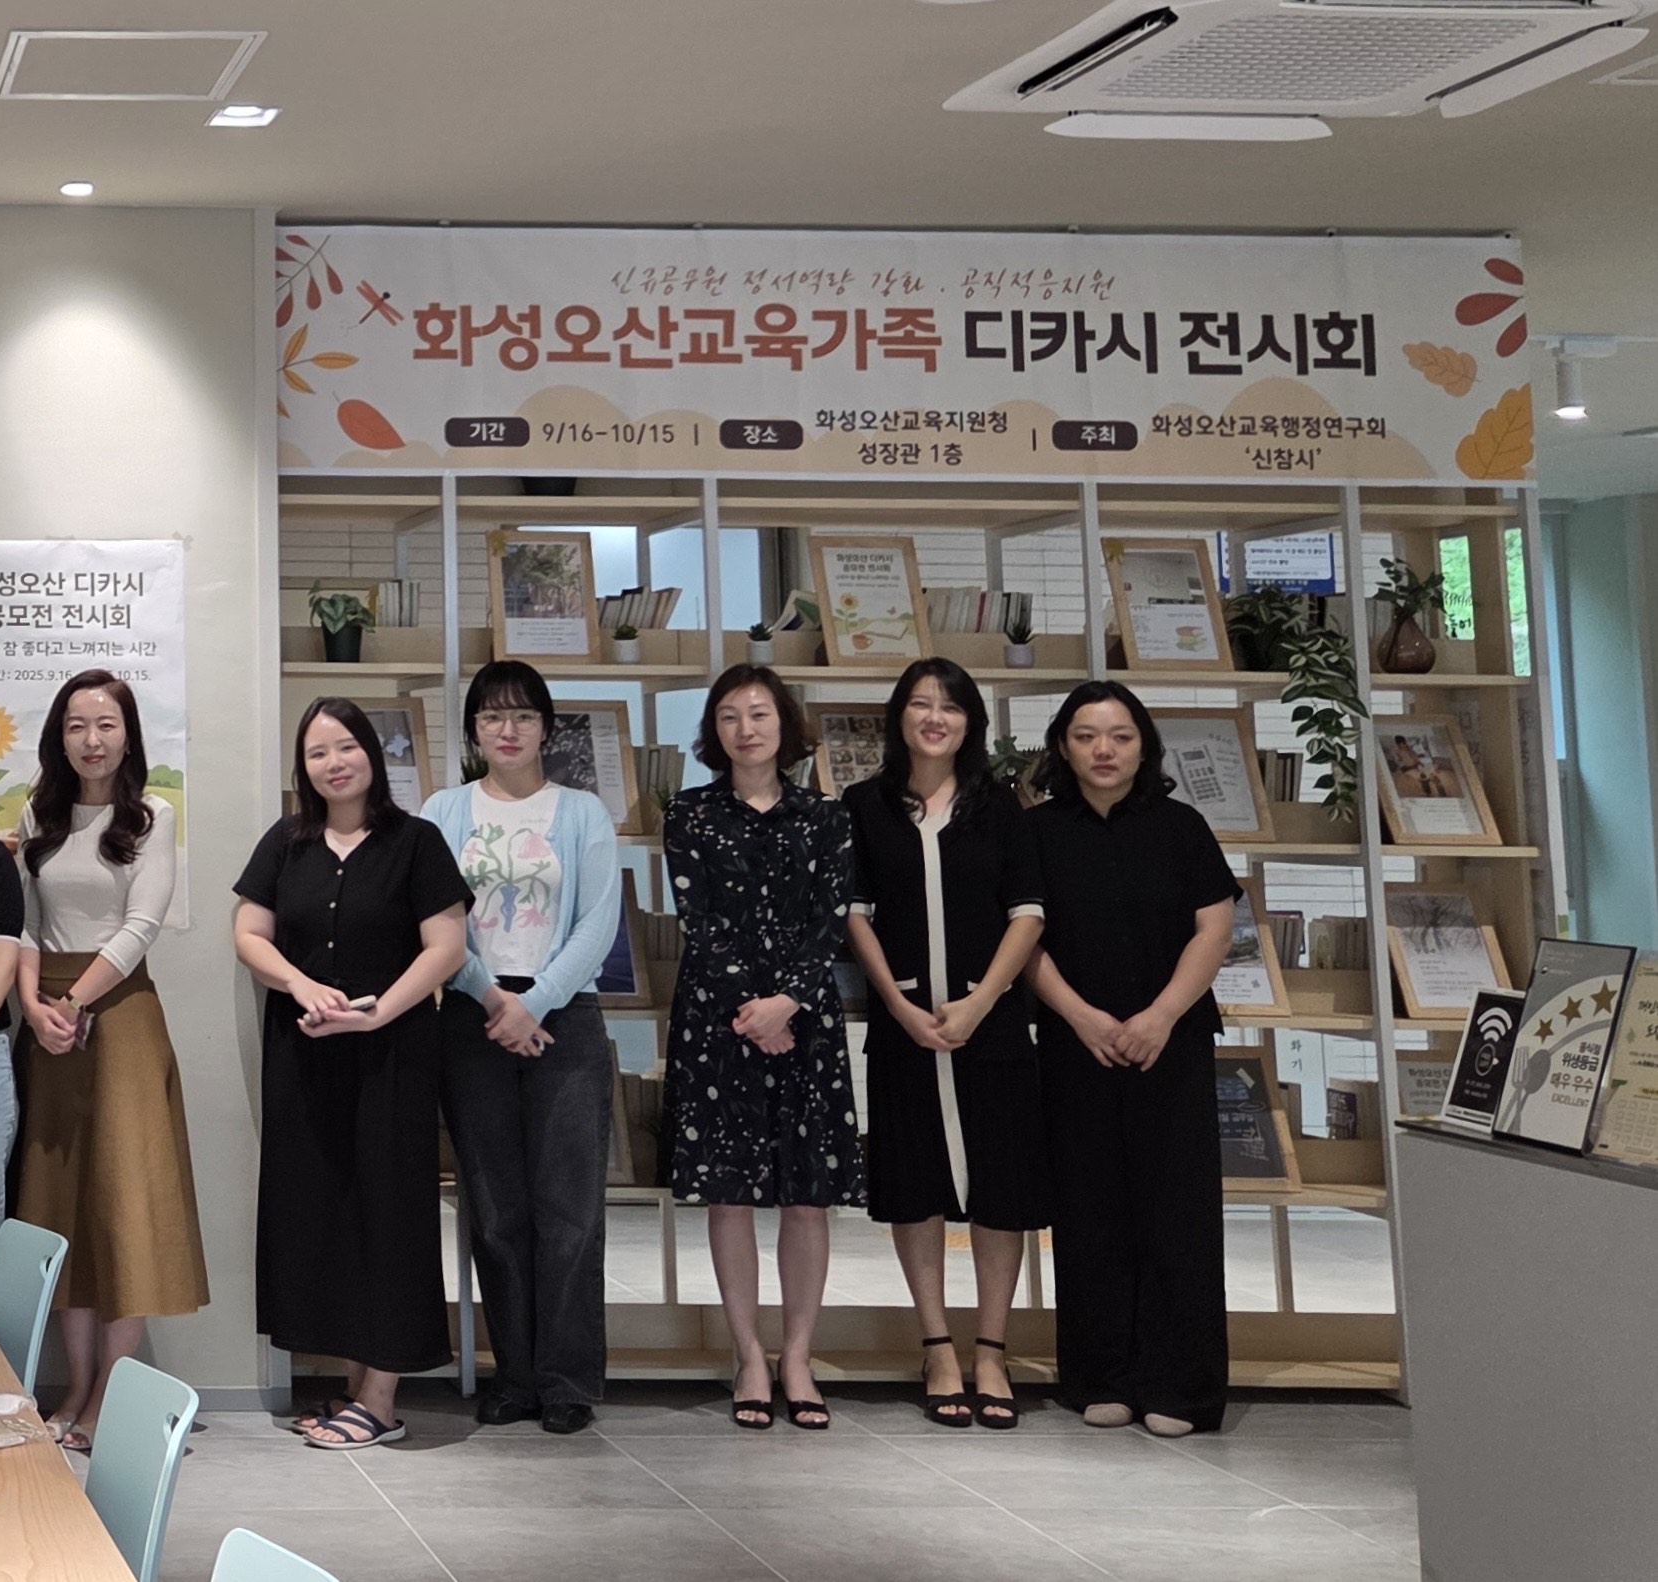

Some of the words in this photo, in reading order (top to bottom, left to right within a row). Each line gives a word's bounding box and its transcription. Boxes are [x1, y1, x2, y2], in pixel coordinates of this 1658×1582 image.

[610, 265, 729, 296] 신규공무원
[742, 268, 856, 296] 정서역량
[871, 268, 925, 297] 강화
[960, 267, 1116, 301] 공직적응지원
[412, 302, 943, 373] 화성오산교육가족
[963, 309, 1159, 375] 디카시
[1178, 310, 1377, 377] 전시회
[469, 421, 506, 443] 기간
[542, 422, 675, 445] 9/16-10/15
[815, 409, 1008, 434] 화성오산교육지원청
[1150, 413, 1387, 439] 화성오산교육행정연구회
[742, 424, 780, 445] 장소
[1080, 423, 1117, 445] 주최
[857, 442, 920, 466] 성장관
[930, 443, 963, 466] 1층
[74, 571, 145, 597] 디카시
[62, 604, 132, 630] 전시회
[3, 641, 17, 657] 참
[21, 641, 63, 657] 좋다고
[68, 641, 125, 657] 느껴지는
[129, 641, 157, 657] 시간
